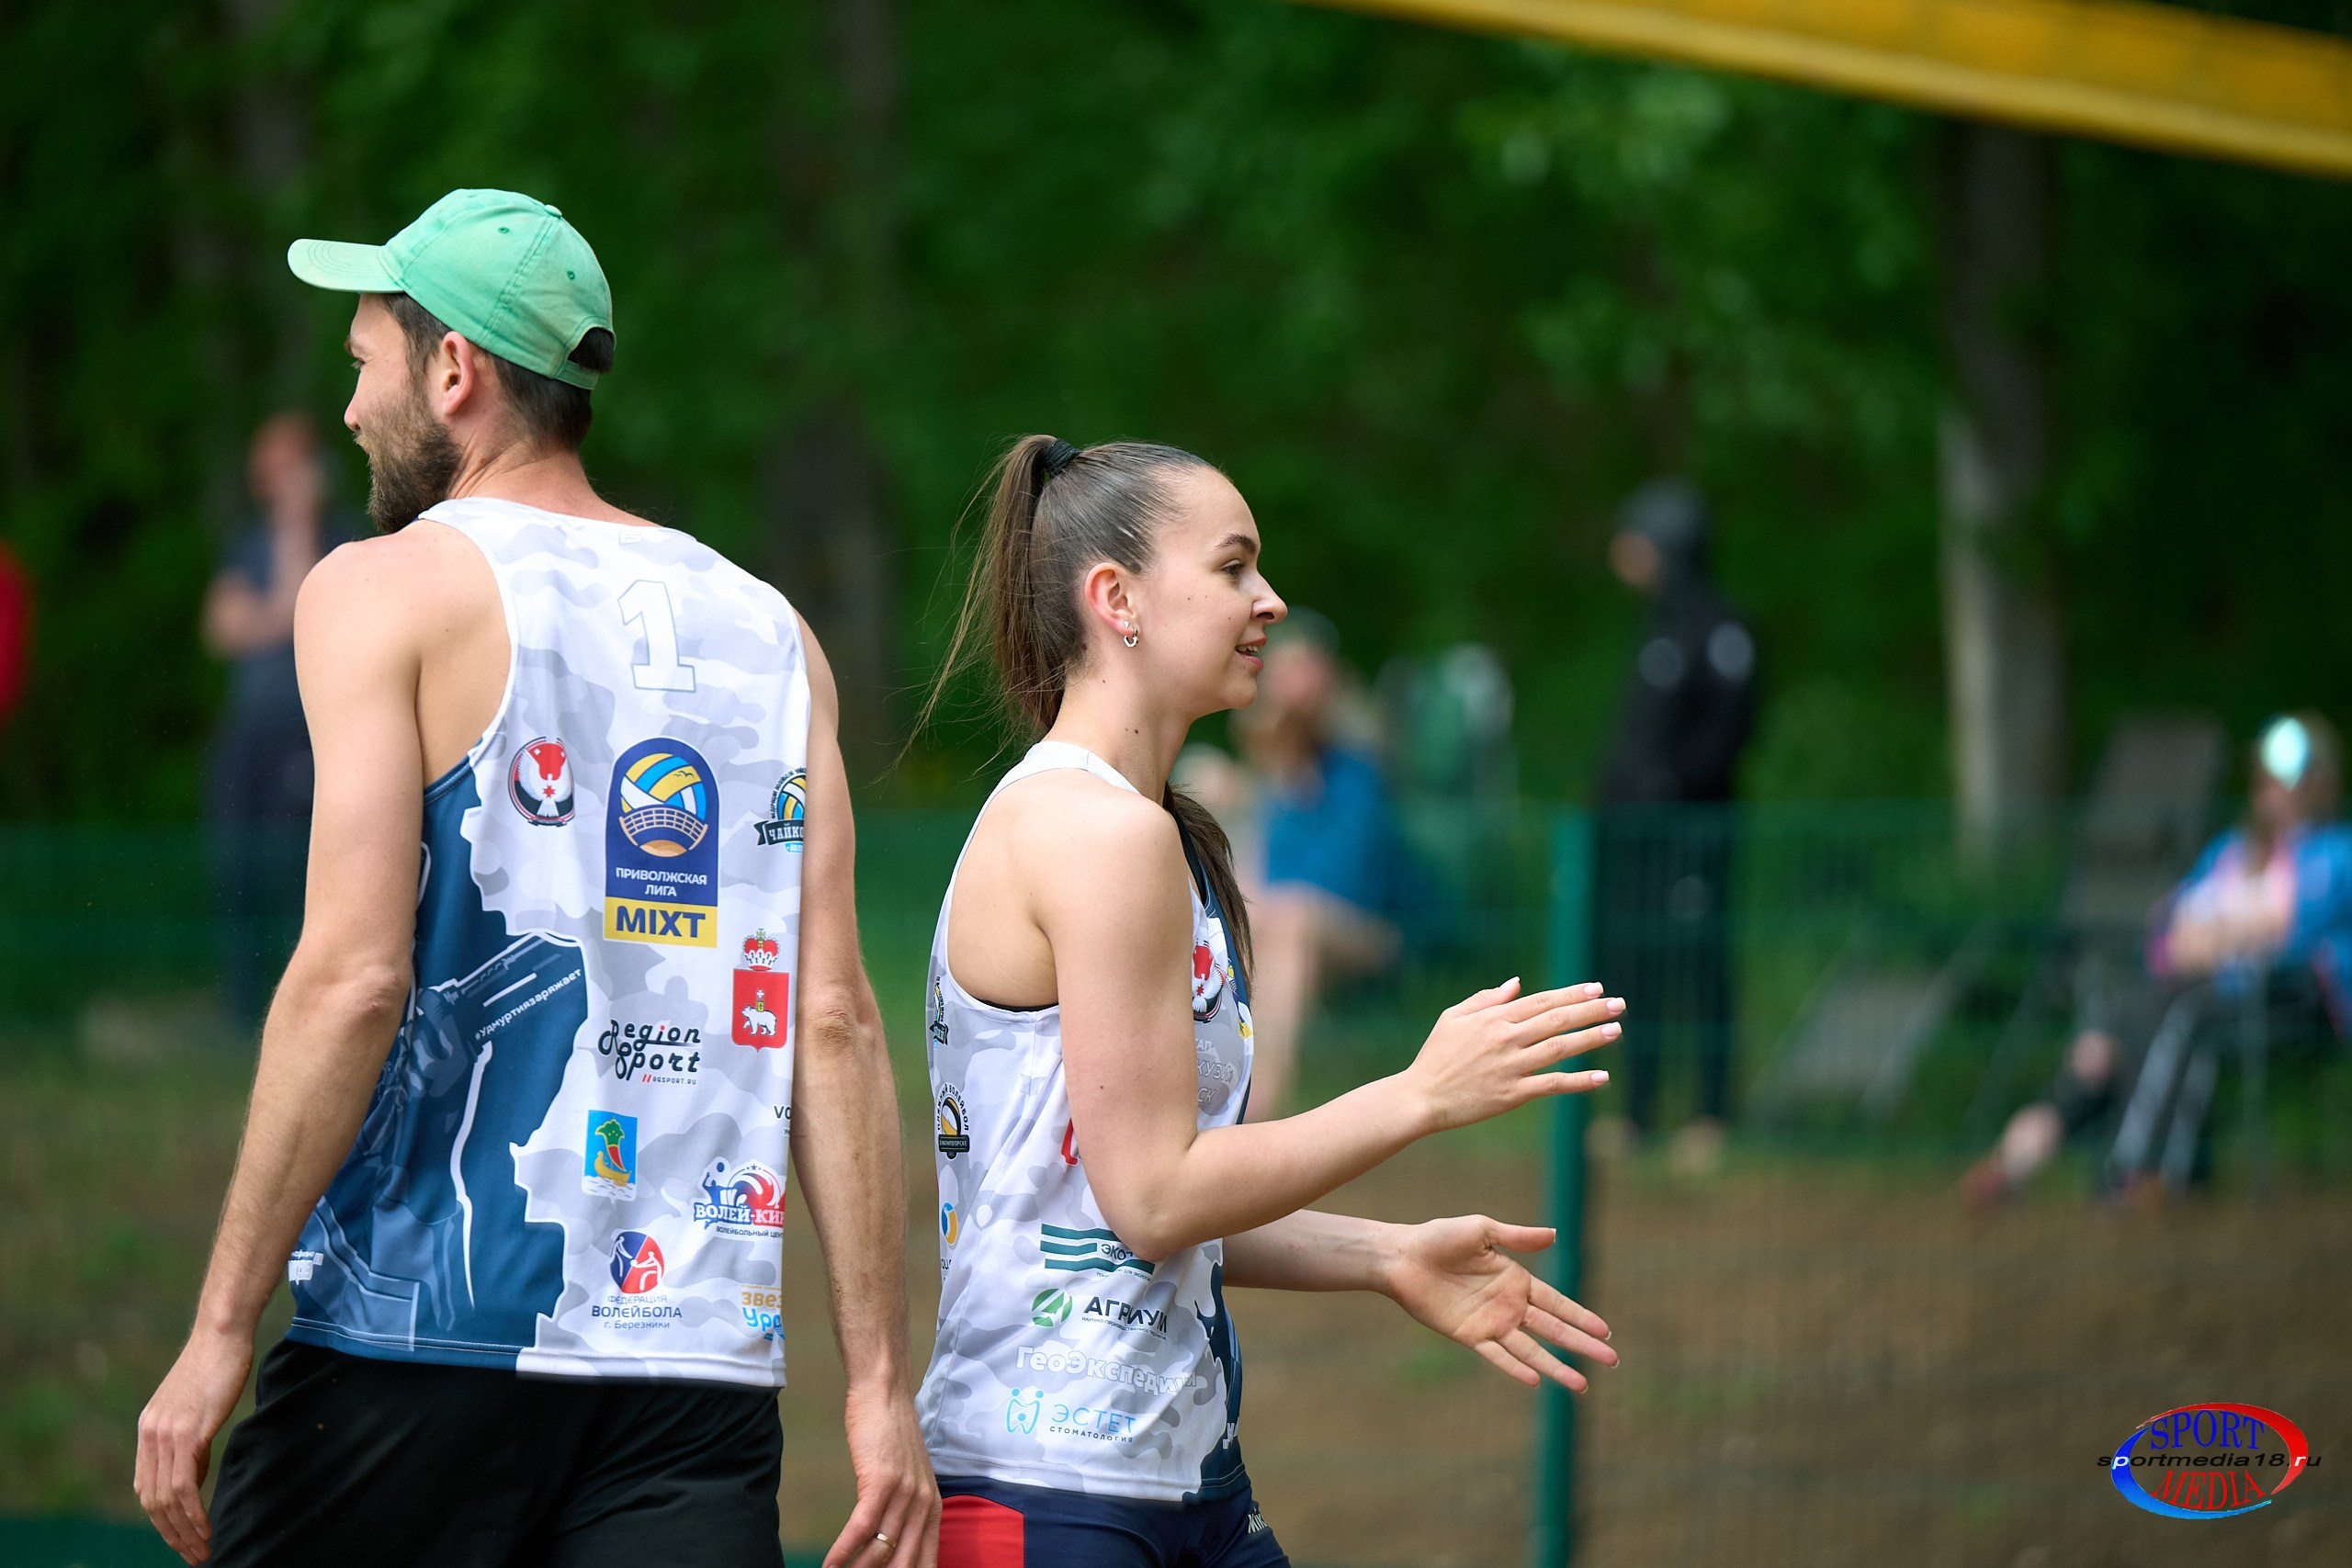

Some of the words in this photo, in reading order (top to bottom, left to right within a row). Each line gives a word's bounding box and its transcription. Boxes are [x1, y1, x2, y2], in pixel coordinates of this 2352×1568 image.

[617, 579, 696, 694] 1
[616, 867, 707, 886] ПРИВОЛЖСКАЯ
[645, 884, 677, 897] ЛИГА
[616, 905, 706, 938] MIXT
[598, 1019, 701, 1055] Region
[615, 1042, 700, 1081] Sport
[716, 1225, 769, 1237] ВОЛЕЙБОЛЬНЫЙ
[607, 1295, 667, 1304] ФЕДЕРАЦИЯ
[592, 1305, 683, 1318] ВОЛЕЙБОЛА
[1084, 1296, 1167, 1333] АГРИУМ
[614, 1320, 670, 1330] Березники
[1051, 1404, 1136, 1433] ЭСТЕТ
[1049, 1426, 1133, 1443] СТОМАТОЛОГИЯ
